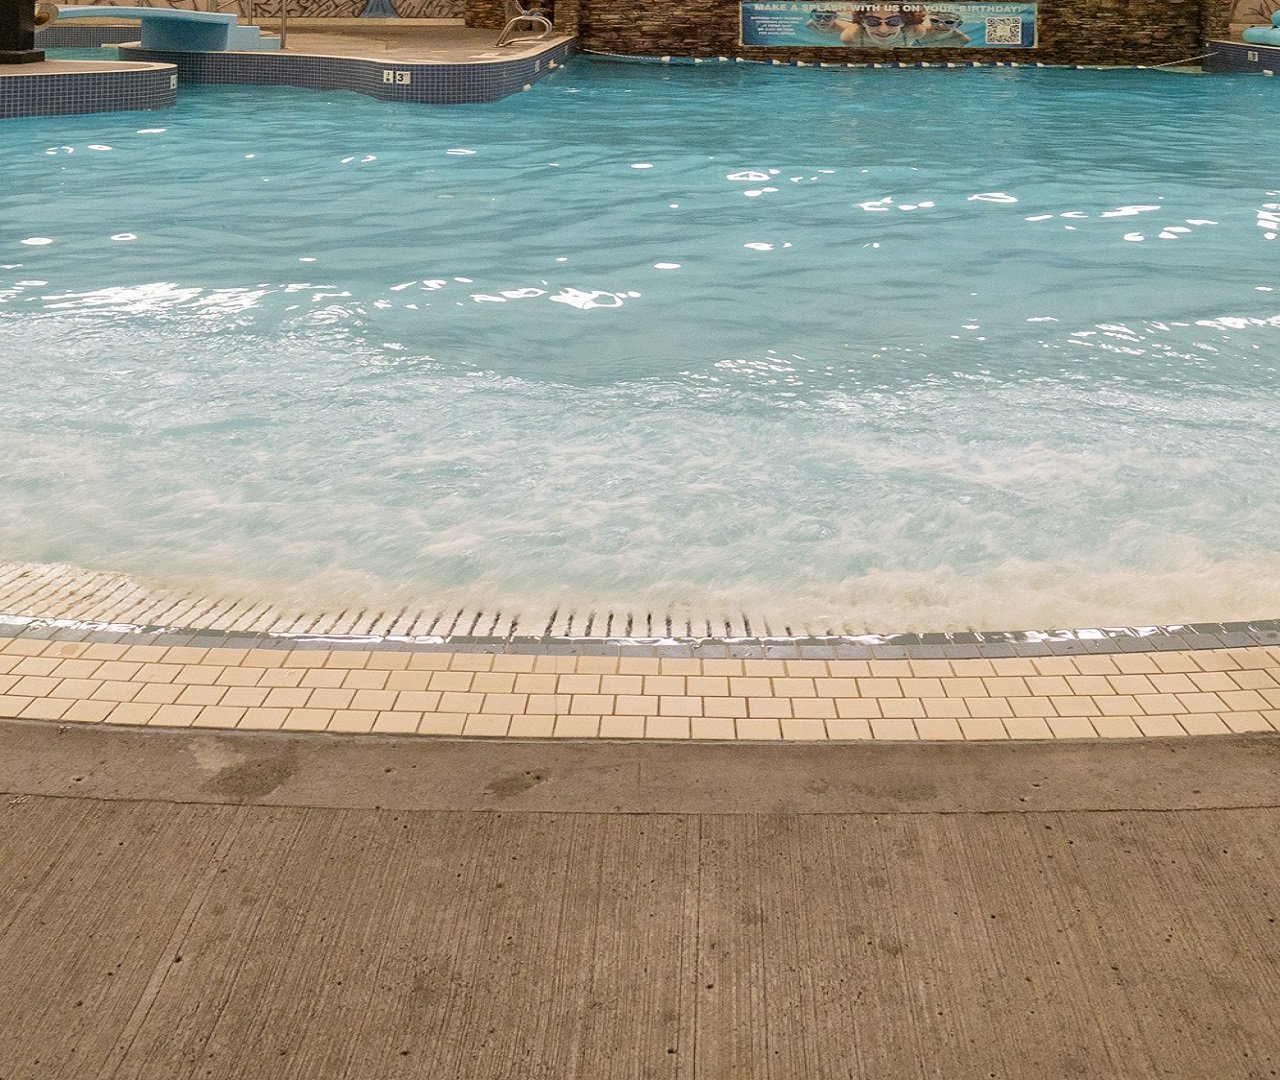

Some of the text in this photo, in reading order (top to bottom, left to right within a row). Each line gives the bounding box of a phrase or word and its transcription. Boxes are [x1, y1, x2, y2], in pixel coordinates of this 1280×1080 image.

[851, 4, 880, 12] WITH
[884, 4, 900, 12] US
[902, 4, 920, 12] ON
[397, 73, 404, 82] 3
